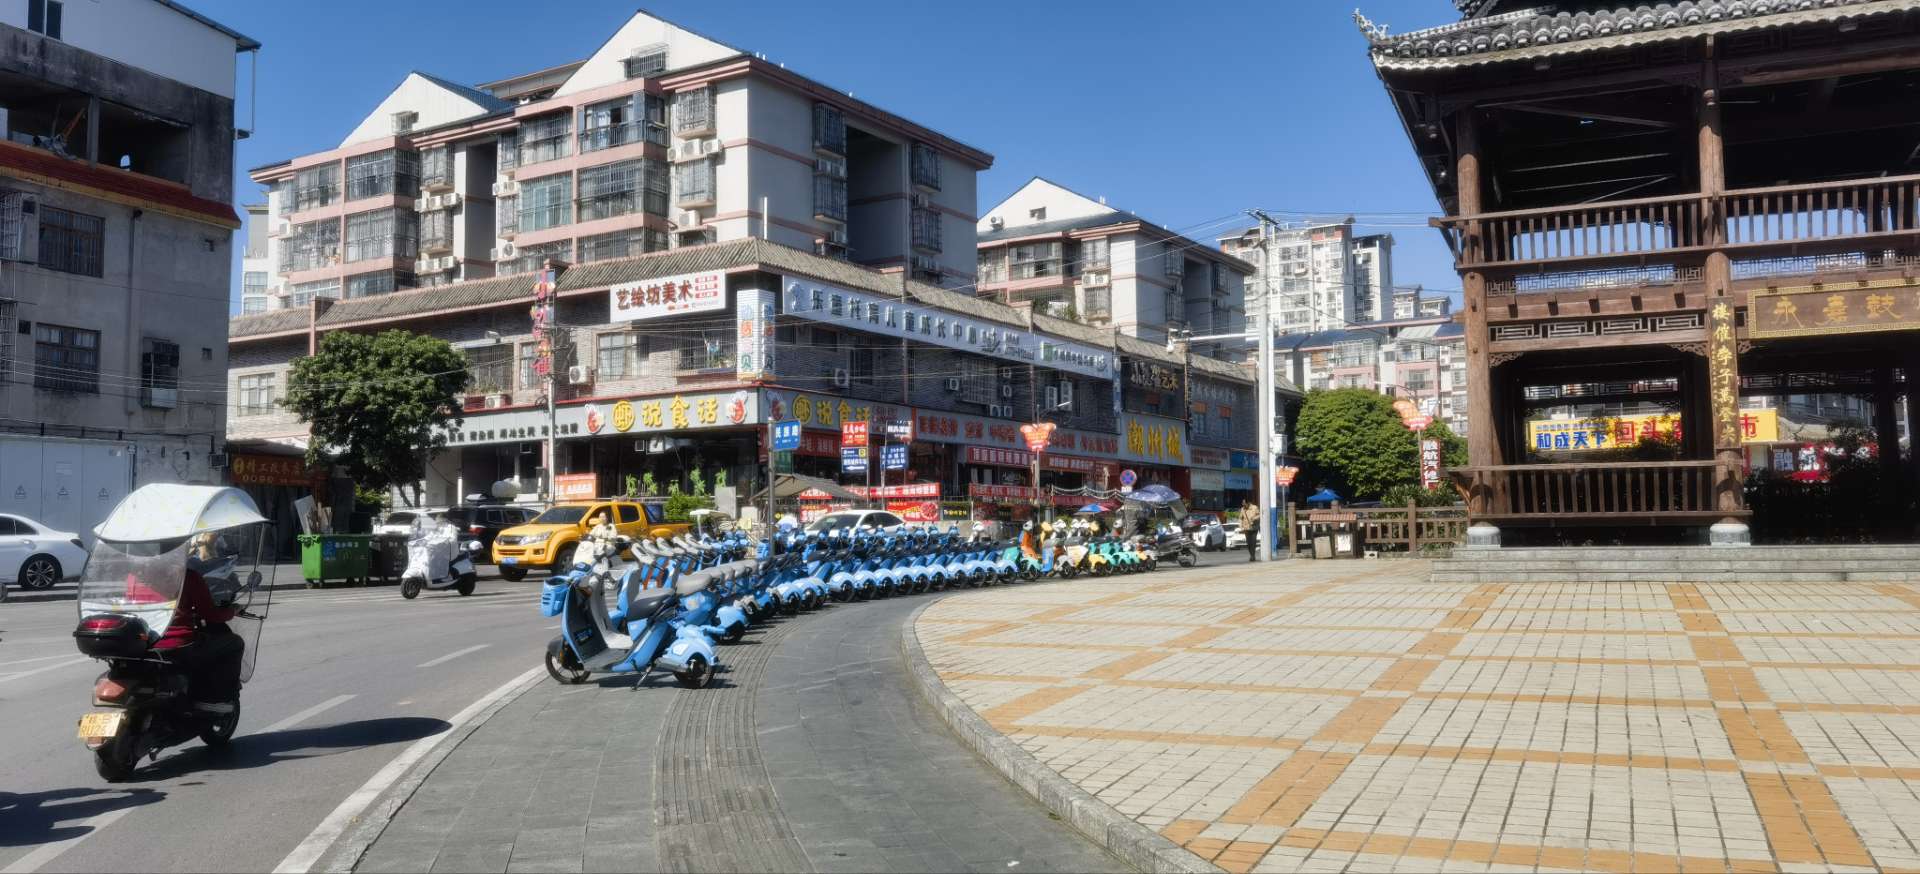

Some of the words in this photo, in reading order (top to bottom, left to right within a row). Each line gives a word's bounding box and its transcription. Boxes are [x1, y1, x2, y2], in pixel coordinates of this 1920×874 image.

[616, 280, 693, 310] 艺绘坊美术
[1536, 431, 1608, 449] 和成天下
